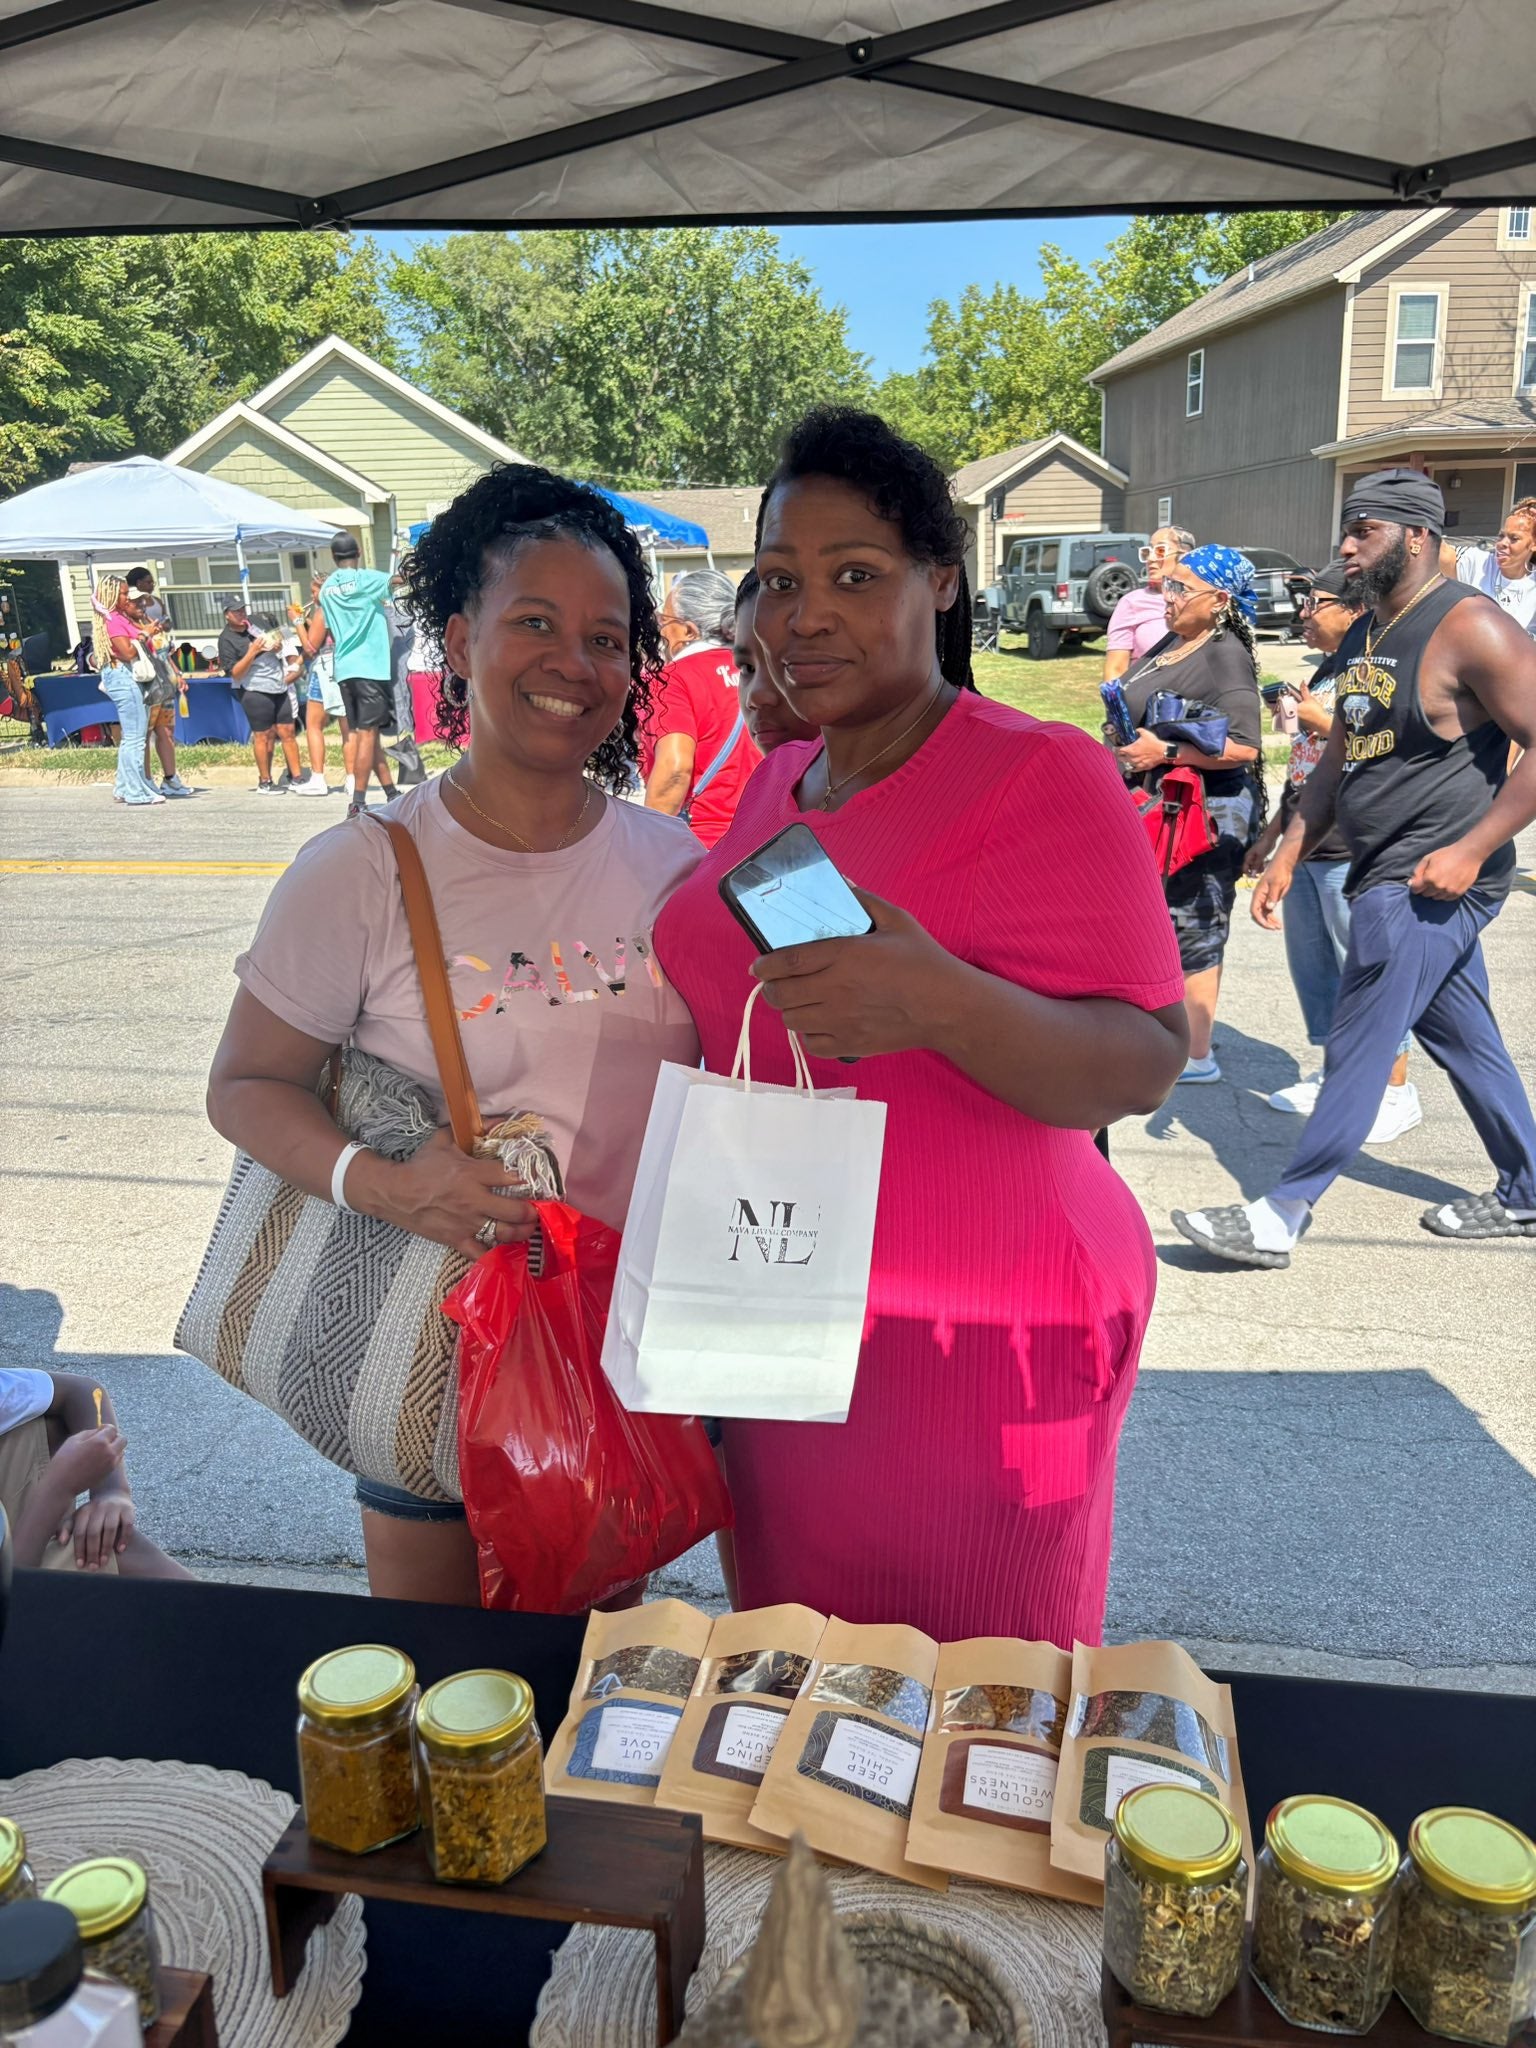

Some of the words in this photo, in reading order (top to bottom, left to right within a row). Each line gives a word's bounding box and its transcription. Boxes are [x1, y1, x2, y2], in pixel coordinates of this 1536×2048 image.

[1346, 656, 1398, 668] COMPTITIVE
[727, 1225, 749, 1235] NAVA
[751, 1227, 779, 1236] LIVING
[780, 1229, 819, 1238] COMPANY
[619, 1737, 661, 1750] LOVE
[621, 1749, 654, 1762] GUT
[848, 1751, 894, 1775] CHILL
[847, 1764, 889, 1786] DEEP
[969, 1775, 1054, 1800] WELLNESS
[977, 1787, 1044, 1809] GOLDEN
